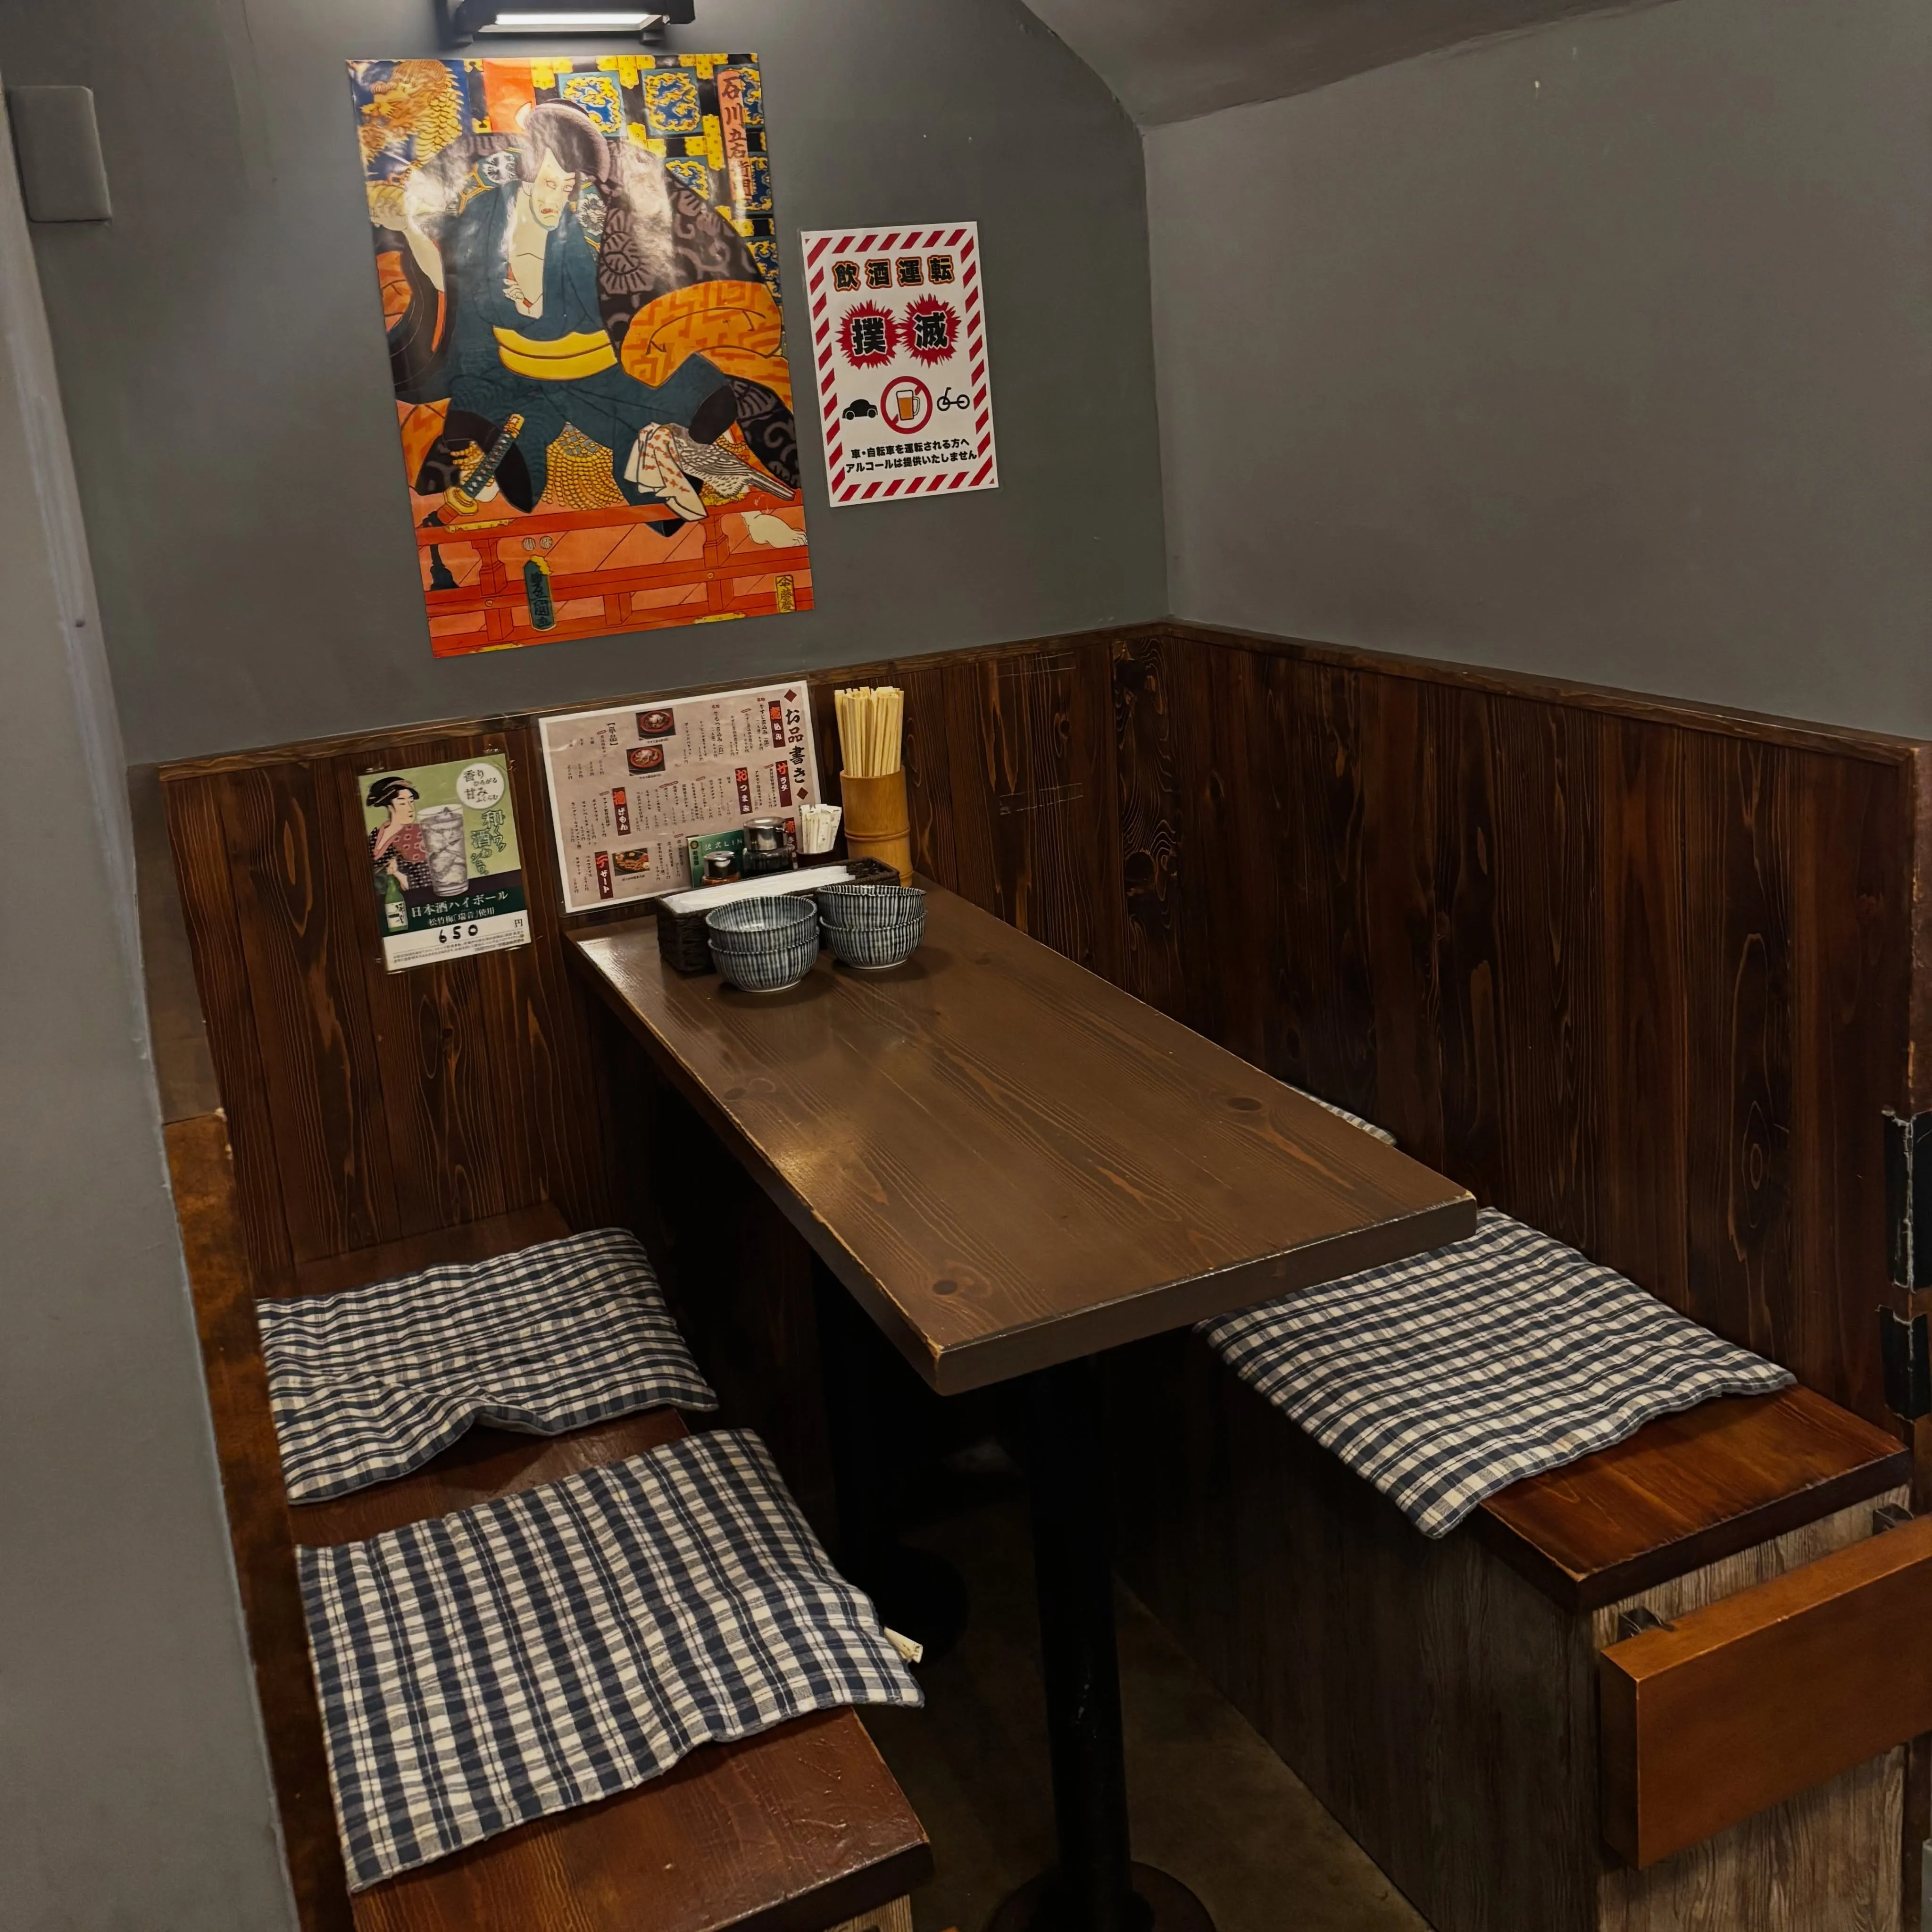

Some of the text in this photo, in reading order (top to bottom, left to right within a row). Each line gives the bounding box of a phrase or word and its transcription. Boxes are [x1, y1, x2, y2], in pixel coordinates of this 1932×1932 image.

[833, 256, 954, 291] 飲酒運転
[850, 312, 948, 355] 撲滅
[851, 438, 970, 458] 車・自転車を運転される方へ
[846, 450, 977, 473] アルコールは提供いたしません
[785, 709, 806, 783] お品書き
[463, 769, 484, 783] 香り
[777, 762, 788, 791] サラダ
[464, 787, 488, 800] 甘み
[736, 770, 750, 812] おつまみ
[411, 891, 509, 918] 日本酒ハイボール
[439, 924, 479, 943] 650
[514, 918, 523, 927] 円
